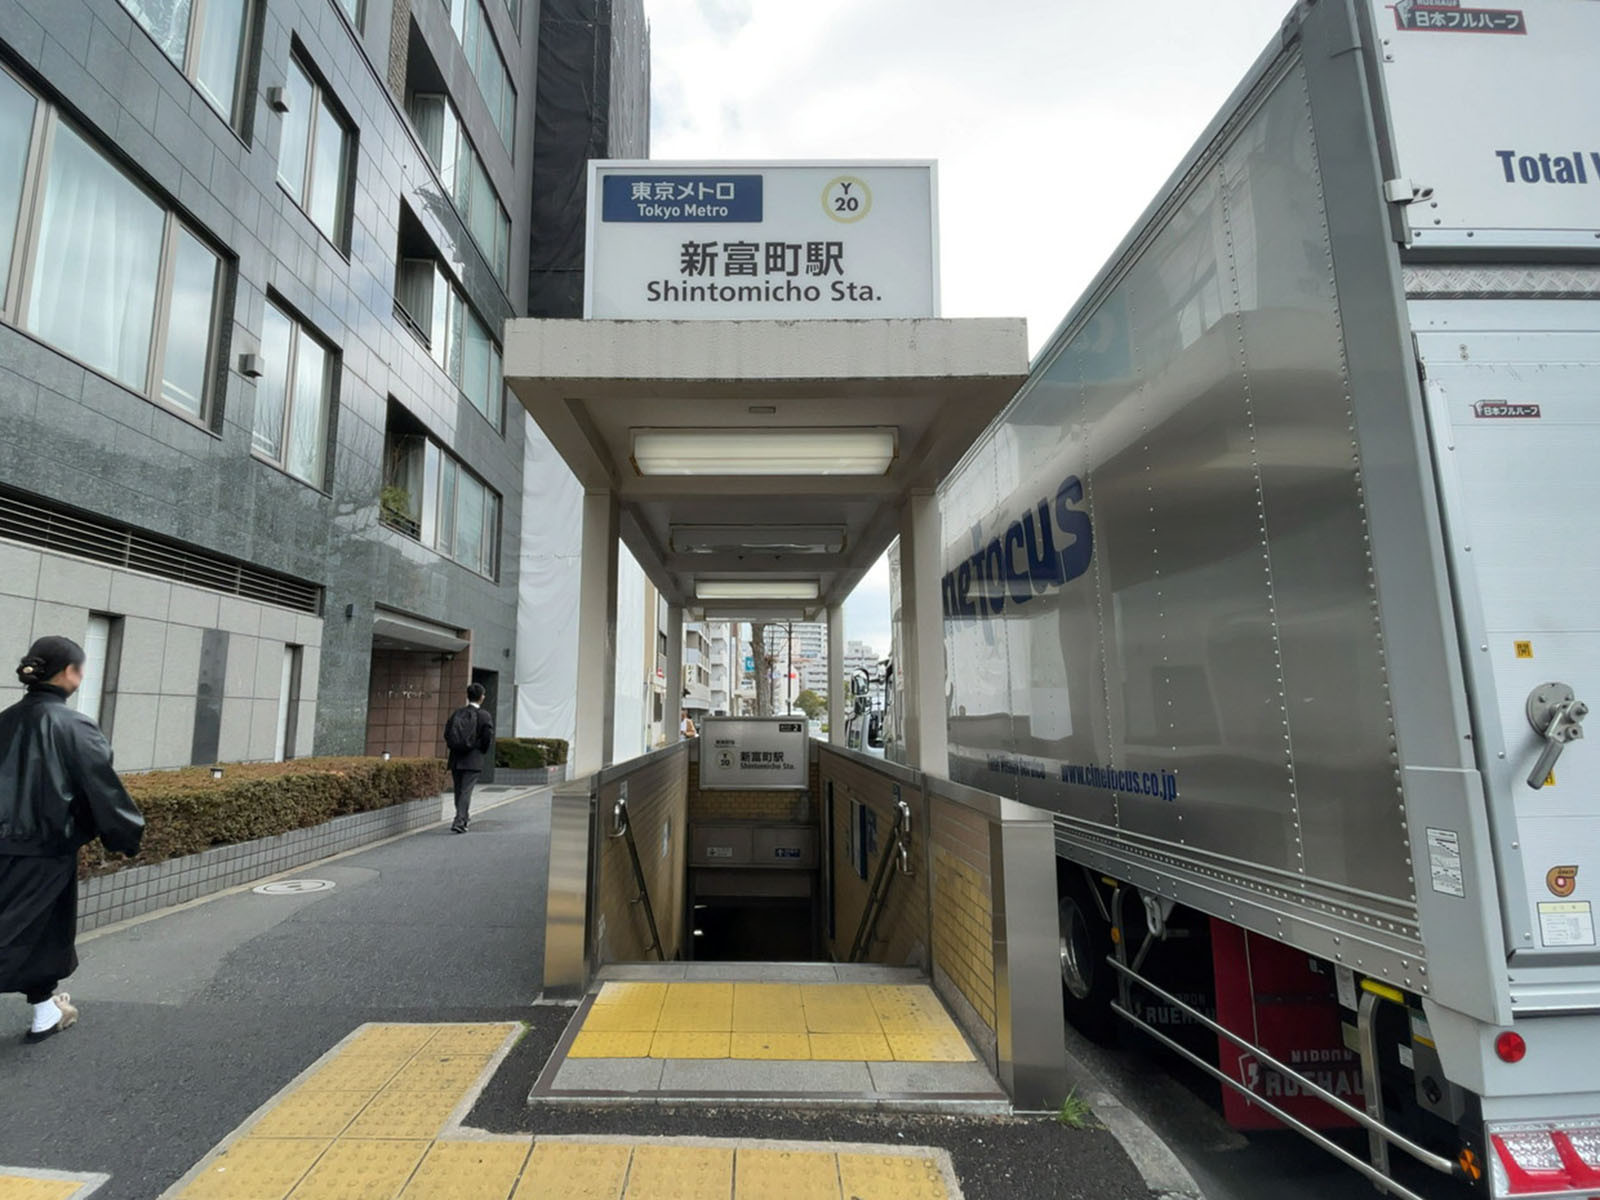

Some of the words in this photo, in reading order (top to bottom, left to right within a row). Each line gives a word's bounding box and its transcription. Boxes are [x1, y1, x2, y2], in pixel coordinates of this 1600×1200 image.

[1415, 11, 1520, 30] 日本フルハーフ
[1495, 150, 1588, 184] Total
[631, 181, 735, 202] 東京メトロ
[840, 182, 852, 195] Y
[637, 203, 681, 219] Tokyo
[684, 203, 729, 217] Metro
[835, 197, 859, 212] 20
[679, 240, 845, 278] 新富町駅
[646, 279, 821, 303] Shintomicho
[830, 280, 883, 303] Sta.
[740, 751, 785, 763] 新富町駅
[1060, 763, 1177, 802] www.cinefocus.co.jp
